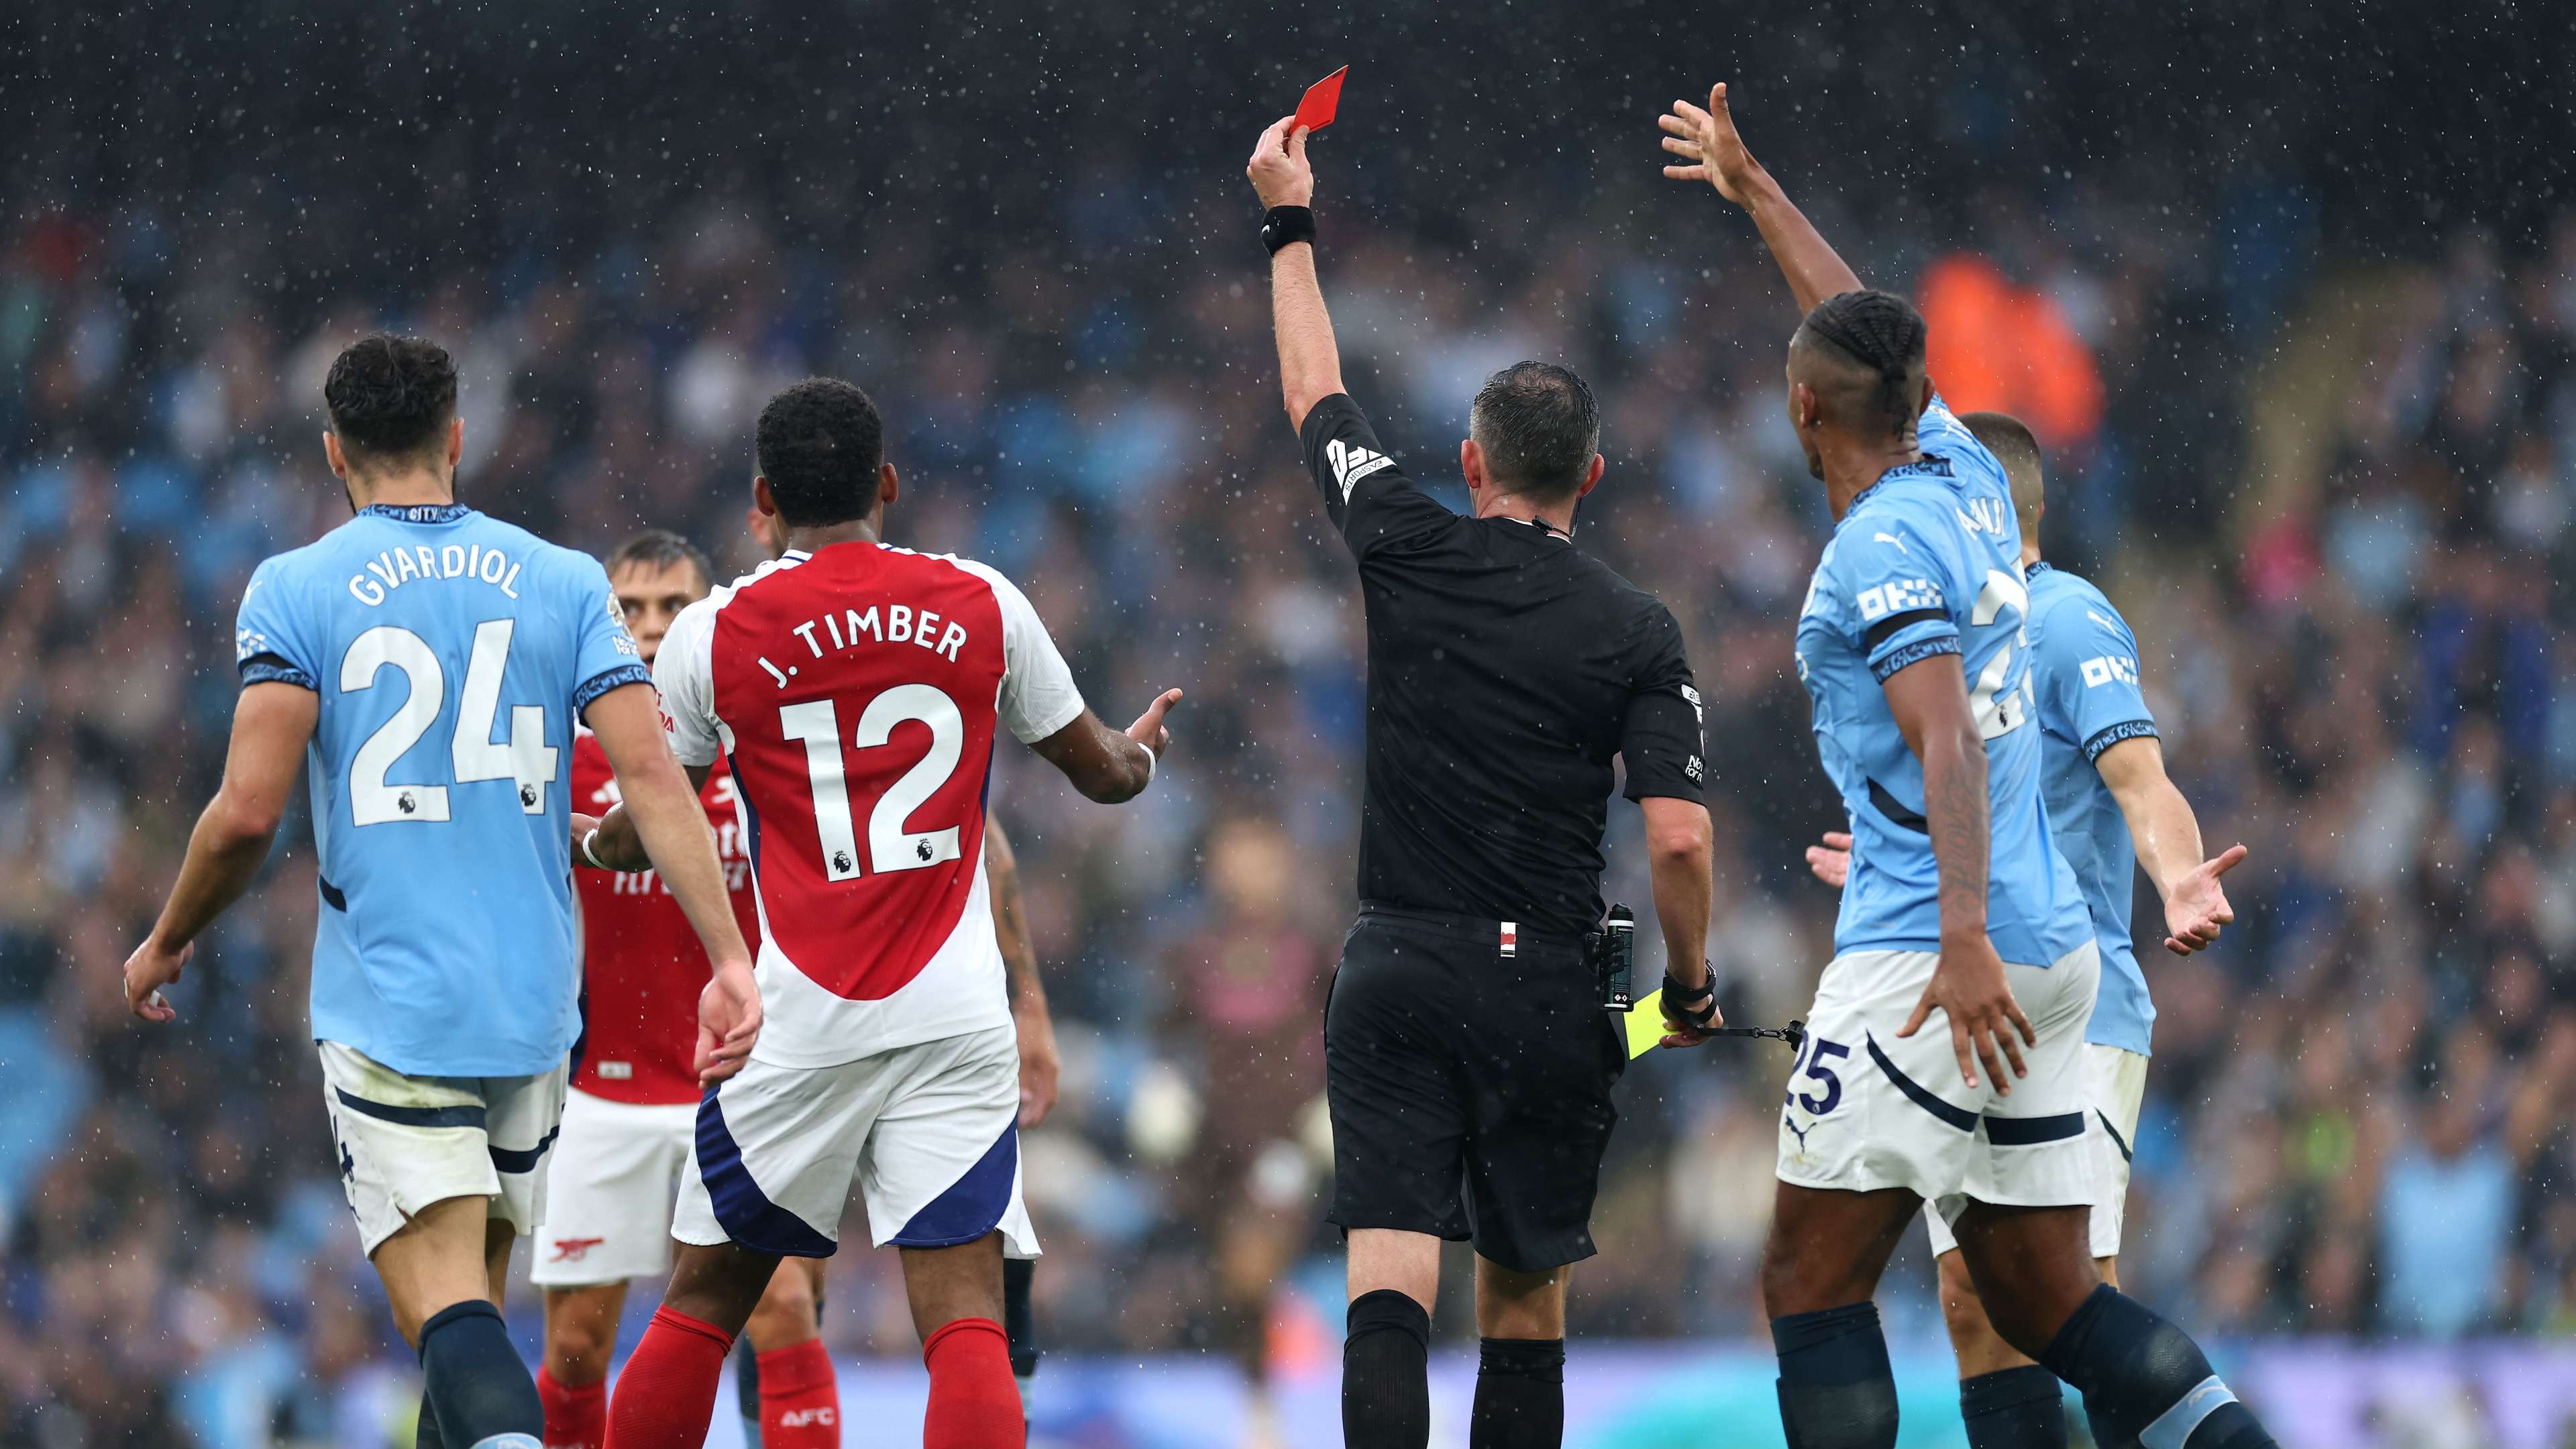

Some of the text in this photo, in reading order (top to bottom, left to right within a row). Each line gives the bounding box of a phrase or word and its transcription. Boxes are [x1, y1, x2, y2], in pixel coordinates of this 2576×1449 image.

[409, 507, 438, 521] CITY
[1955, 496, 2006, 541] ANJI
[348, 544, 522, 607] GVARDIOL
[758, 604, 967, 690] J. TIMBER
[339, 617, 559, 827] 24
[779, 683, 963, 882] 12
[780, 1406, 835, 1428] AFC
